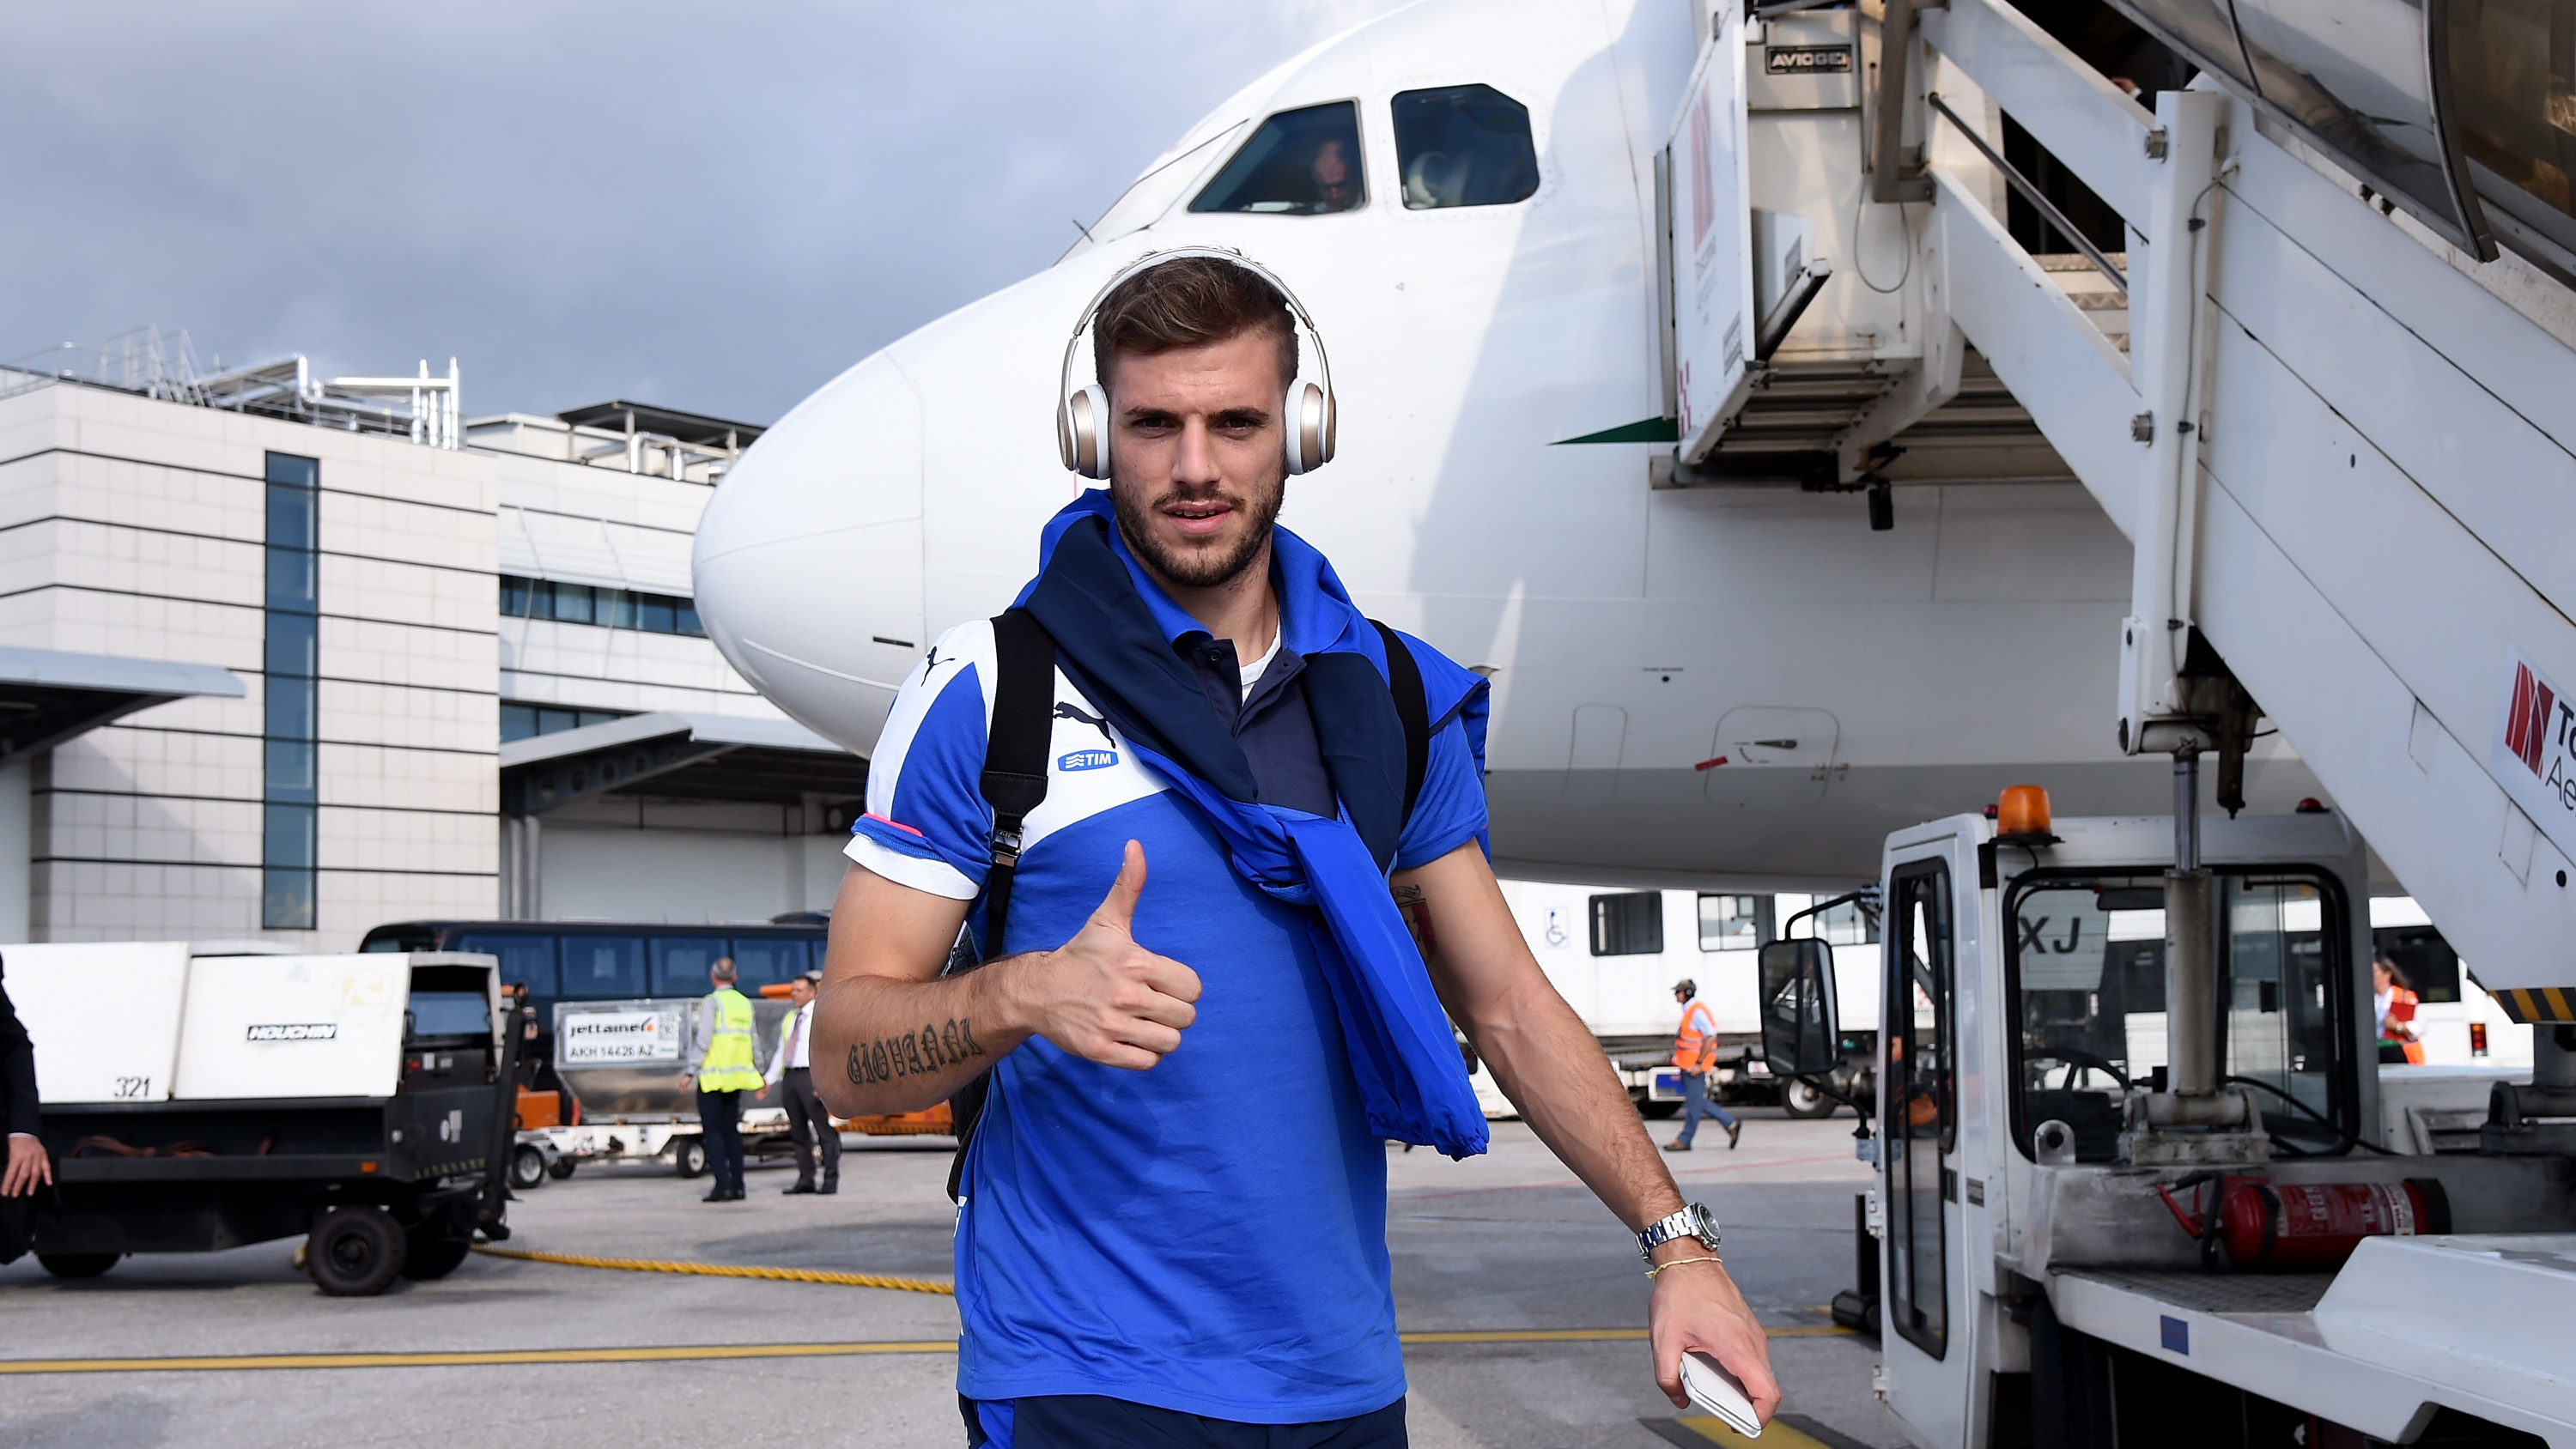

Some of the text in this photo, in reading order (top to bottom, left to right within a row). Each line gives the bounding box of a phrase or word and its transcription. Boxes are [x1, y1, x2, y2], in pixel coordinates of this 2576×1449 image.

[1084, 753, 1112, 766] TIM
[2018, 916, 2081, 954] XJ
[114, 1076, 149, 1097] 321
